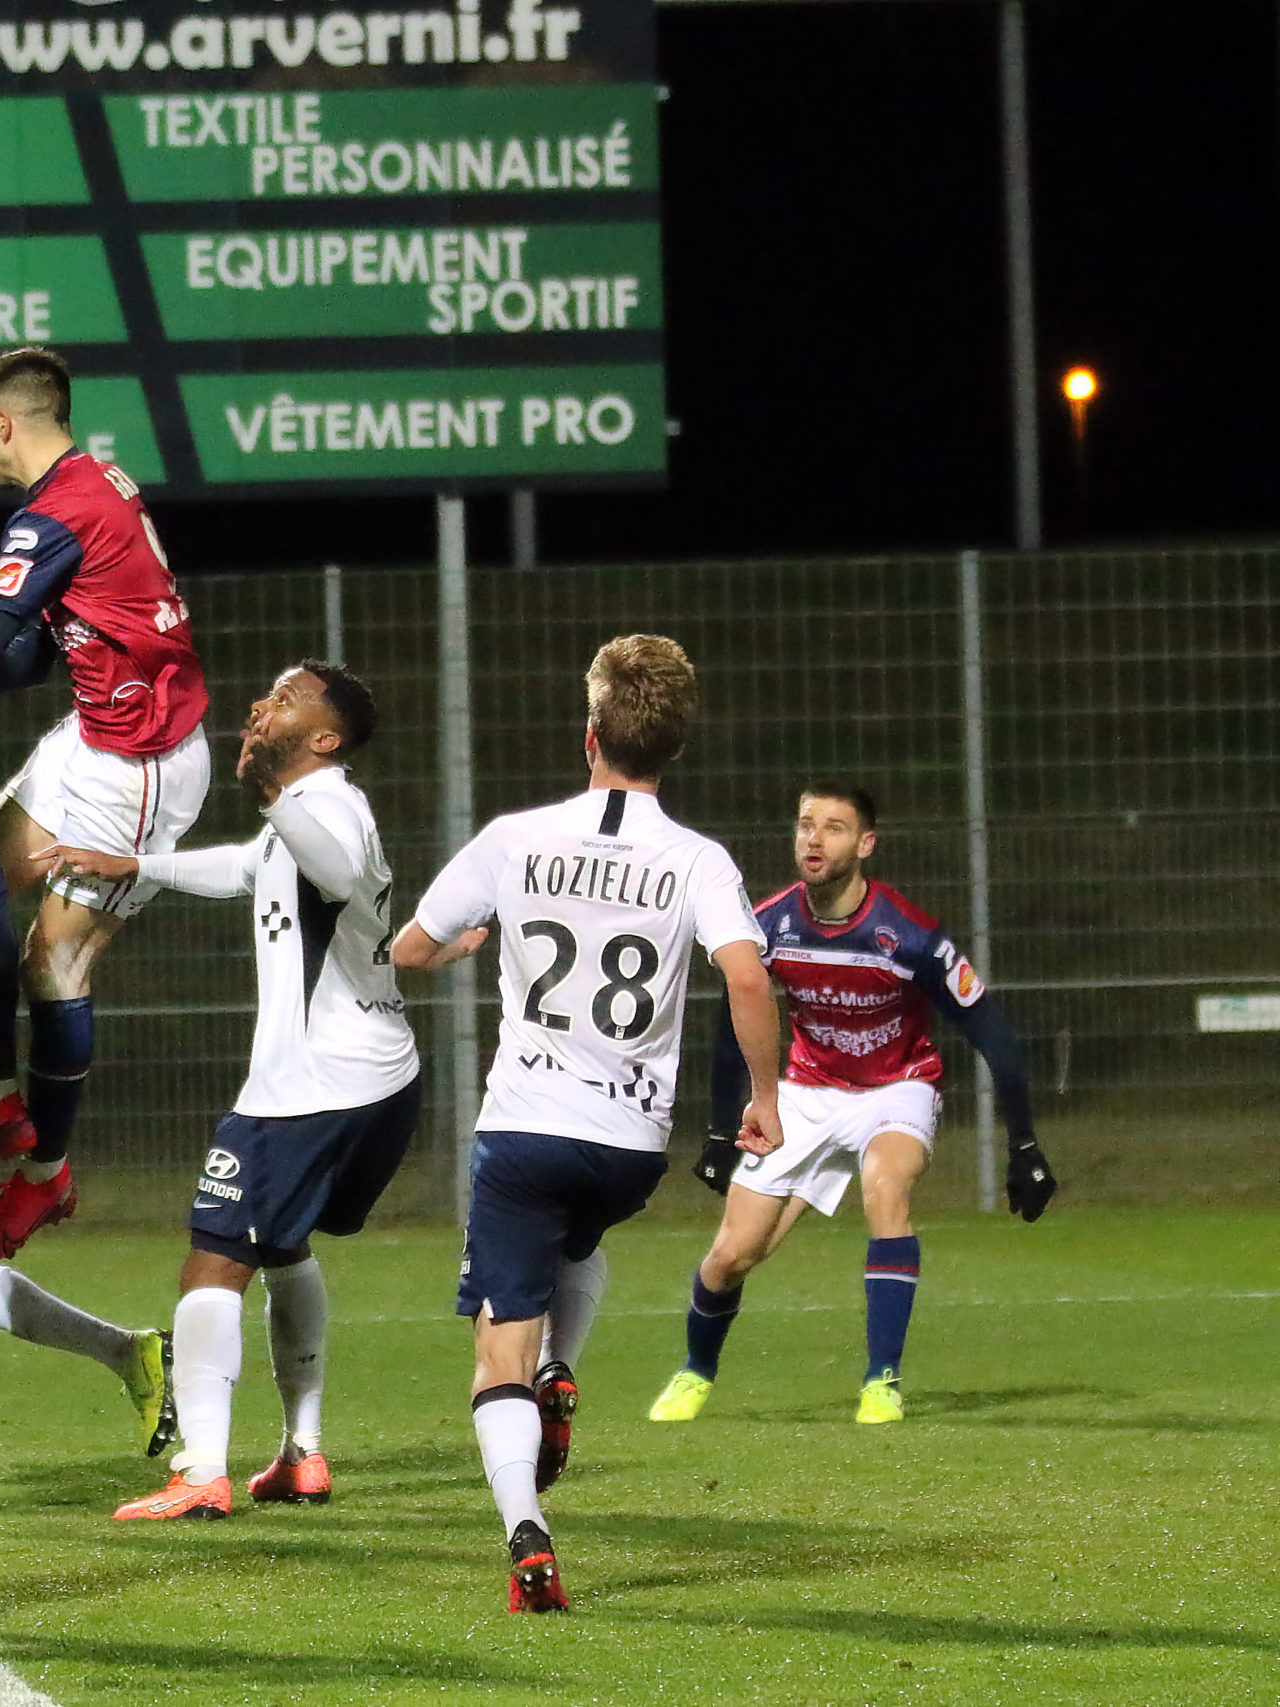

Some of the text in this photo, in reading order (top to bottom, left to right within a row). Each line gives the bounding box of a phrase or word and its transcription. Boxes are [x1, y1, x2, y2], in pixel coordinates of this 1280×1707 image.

[140, 95, 322, 147] TEXTILE
[252, 120, 631, 195] PERSONNALISÉ
[185, 229, 527, 290] EQUIPEMENT
[428, 277, 638, 334] SPORTIF
[225, 394, 635, 453] VÊTEMENT PRO
[523, 853, 676, 912] KOZIELLO
[520, 919, 659, 1041] 28
[775, 949, 812, 960] PATRICK
